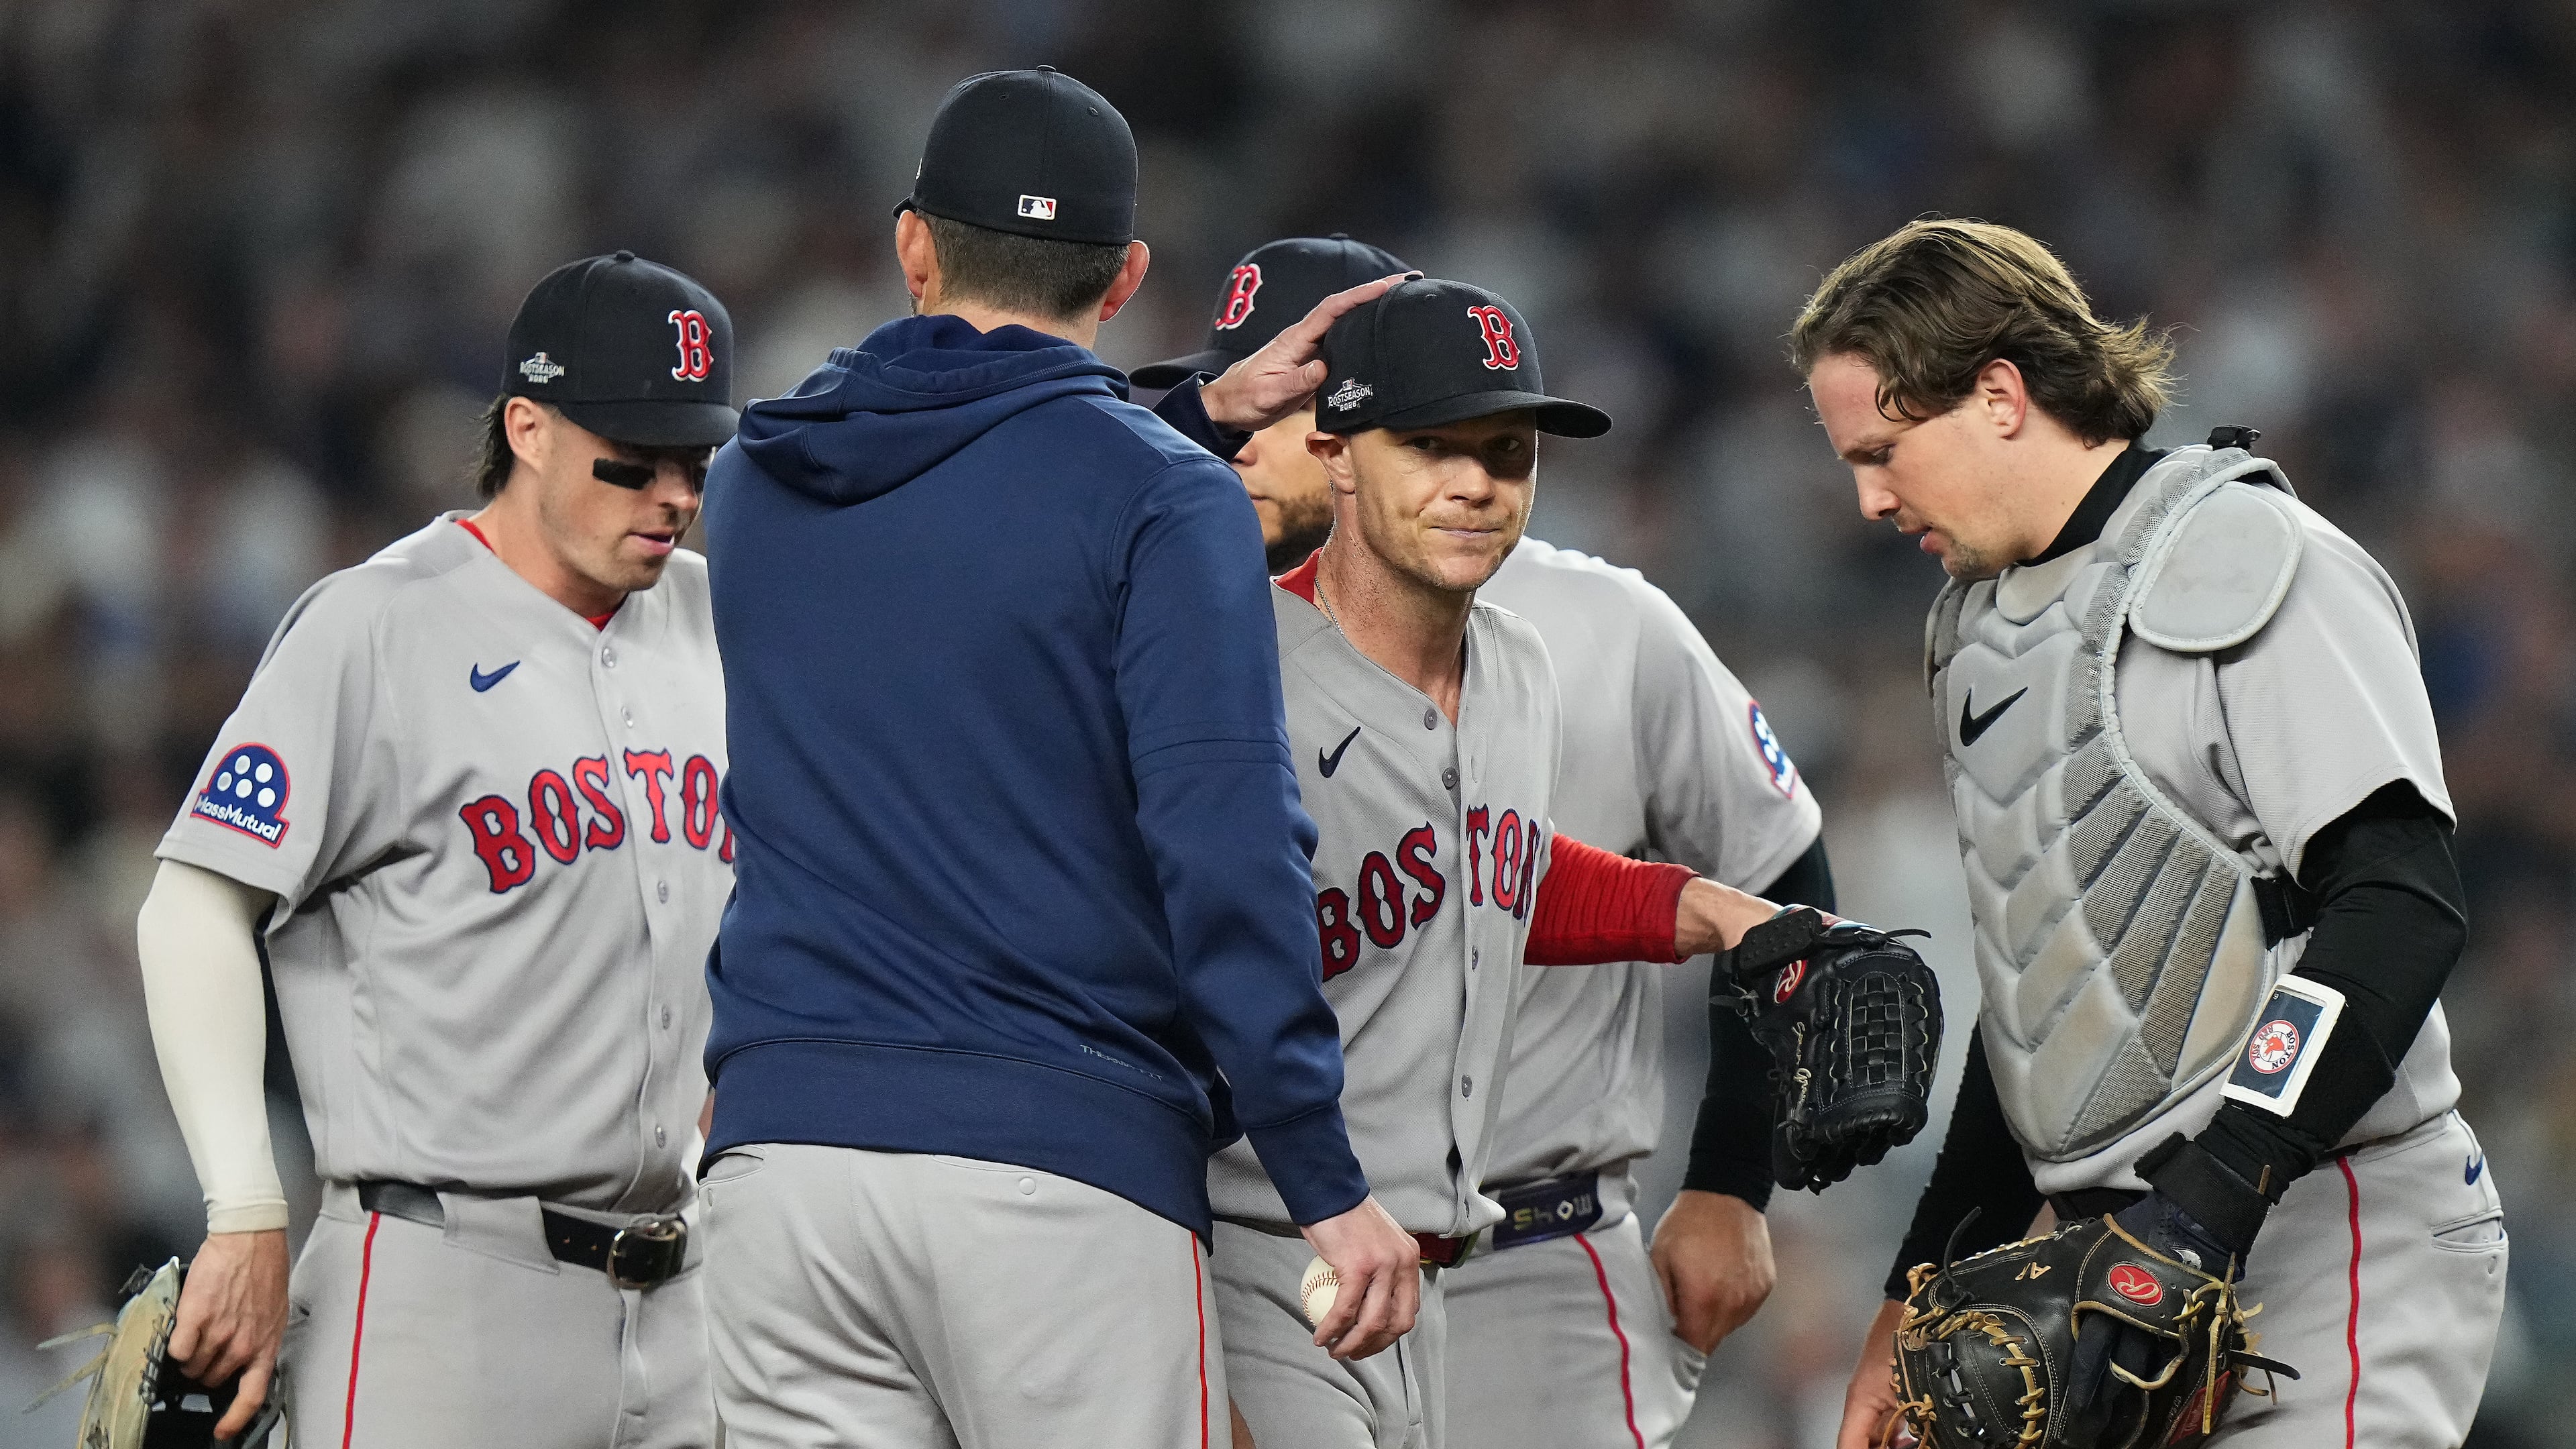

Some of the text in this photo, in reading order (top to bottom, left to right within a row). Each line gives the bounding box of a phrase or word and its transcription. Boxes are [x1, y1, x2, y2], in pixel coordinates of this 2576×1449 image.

[1214, 262, 1264, 331] B
[667, 309, 714, 382] B
[1466, 305, 1521, 371] B
[1328, 386, 1371, 408] POSTSEASON
[194, 796, 282, 841] MassMutual
[2271, 1030, 2296, 1069] BOSTON
